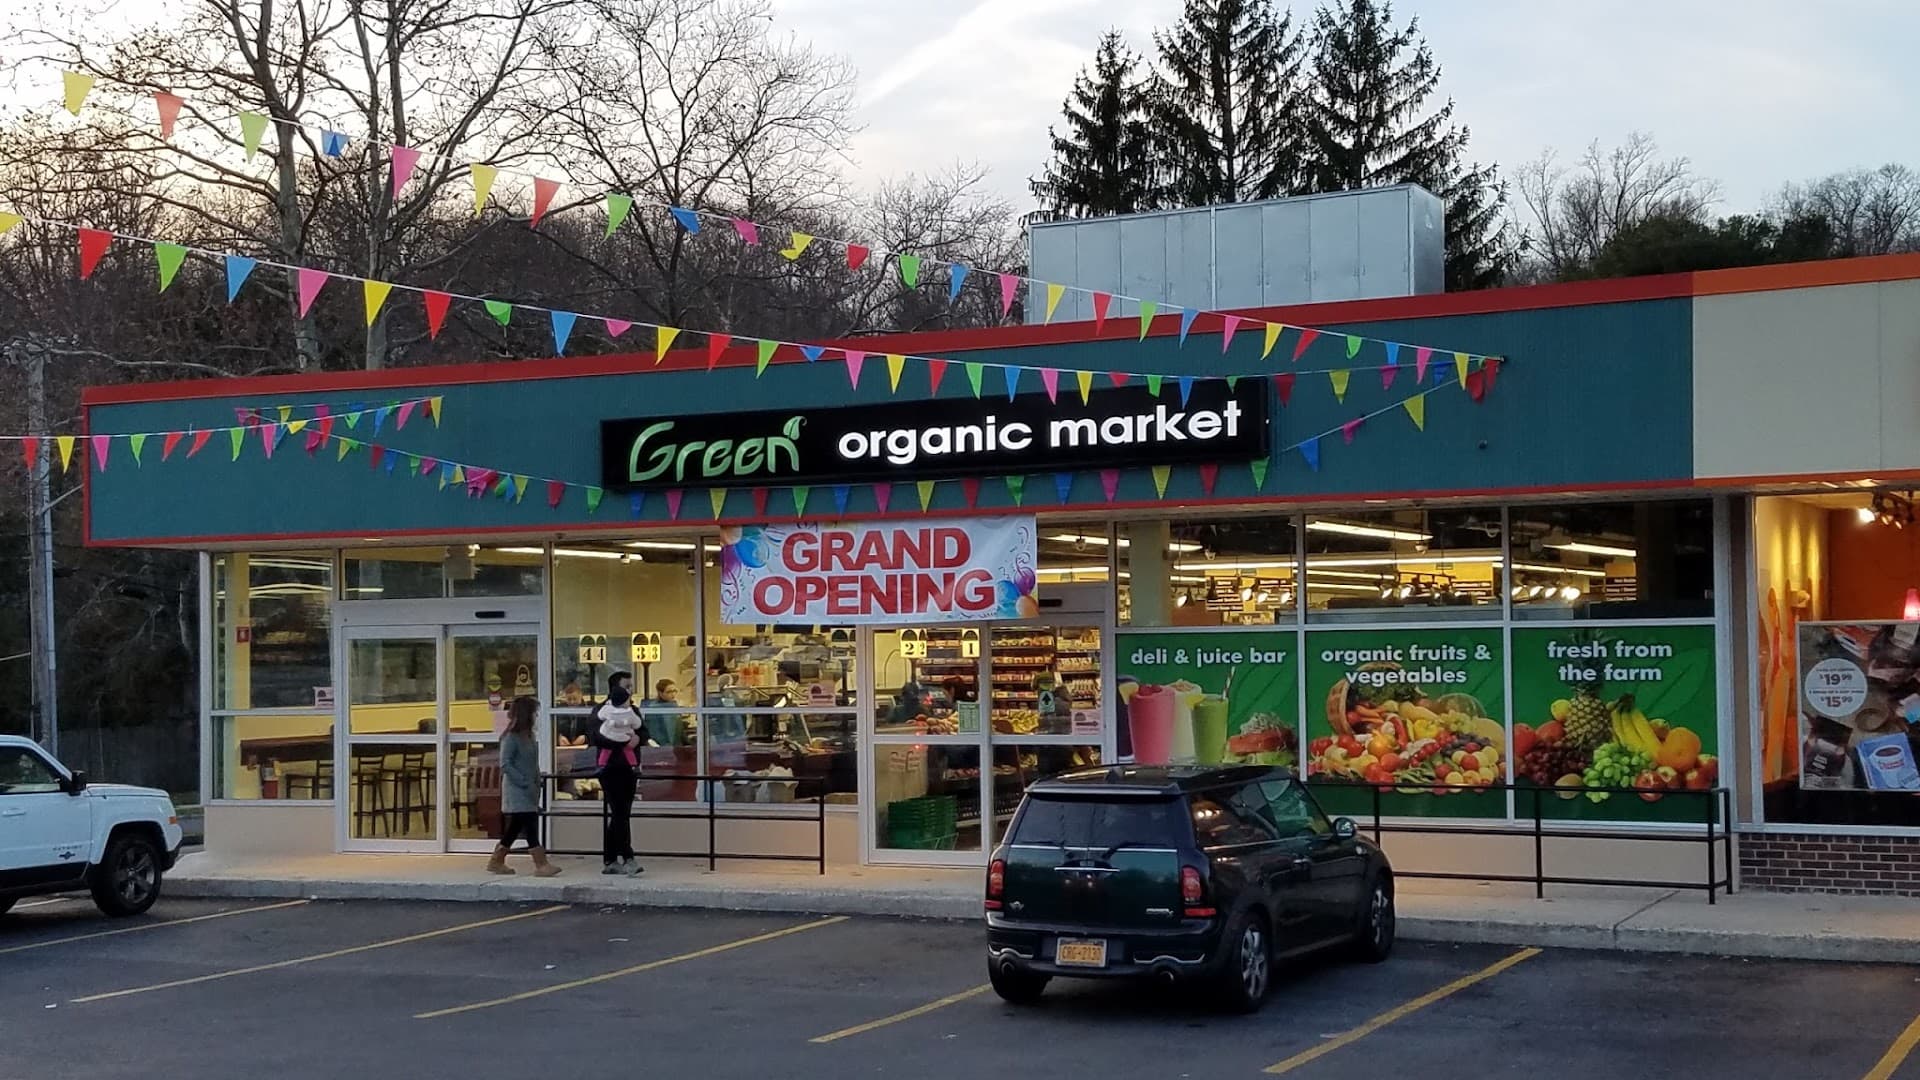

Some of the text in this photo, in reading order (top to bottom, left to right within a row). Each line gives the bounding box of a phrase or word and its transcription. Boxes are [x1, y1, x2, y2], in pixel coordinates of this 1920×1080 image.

[629, 400, 1242, 482] Green organic market
[782, 529, 970, 572] GRAND
[754, 573, 994, 614] OPENING
[582, 647, 592, 661] 4
[636, 647, 646, 660] 3
[905, 643, 915, 656] 2
[1131, 647, 1286, 668] deli & juice bar
[1321, 644, 1491, 666] organic fruits &
[1547, 640, 1672, 658] fresh from
[1345, 666, 1467, 687] vegetables
[1558, 663, 1661, 681] the farm
